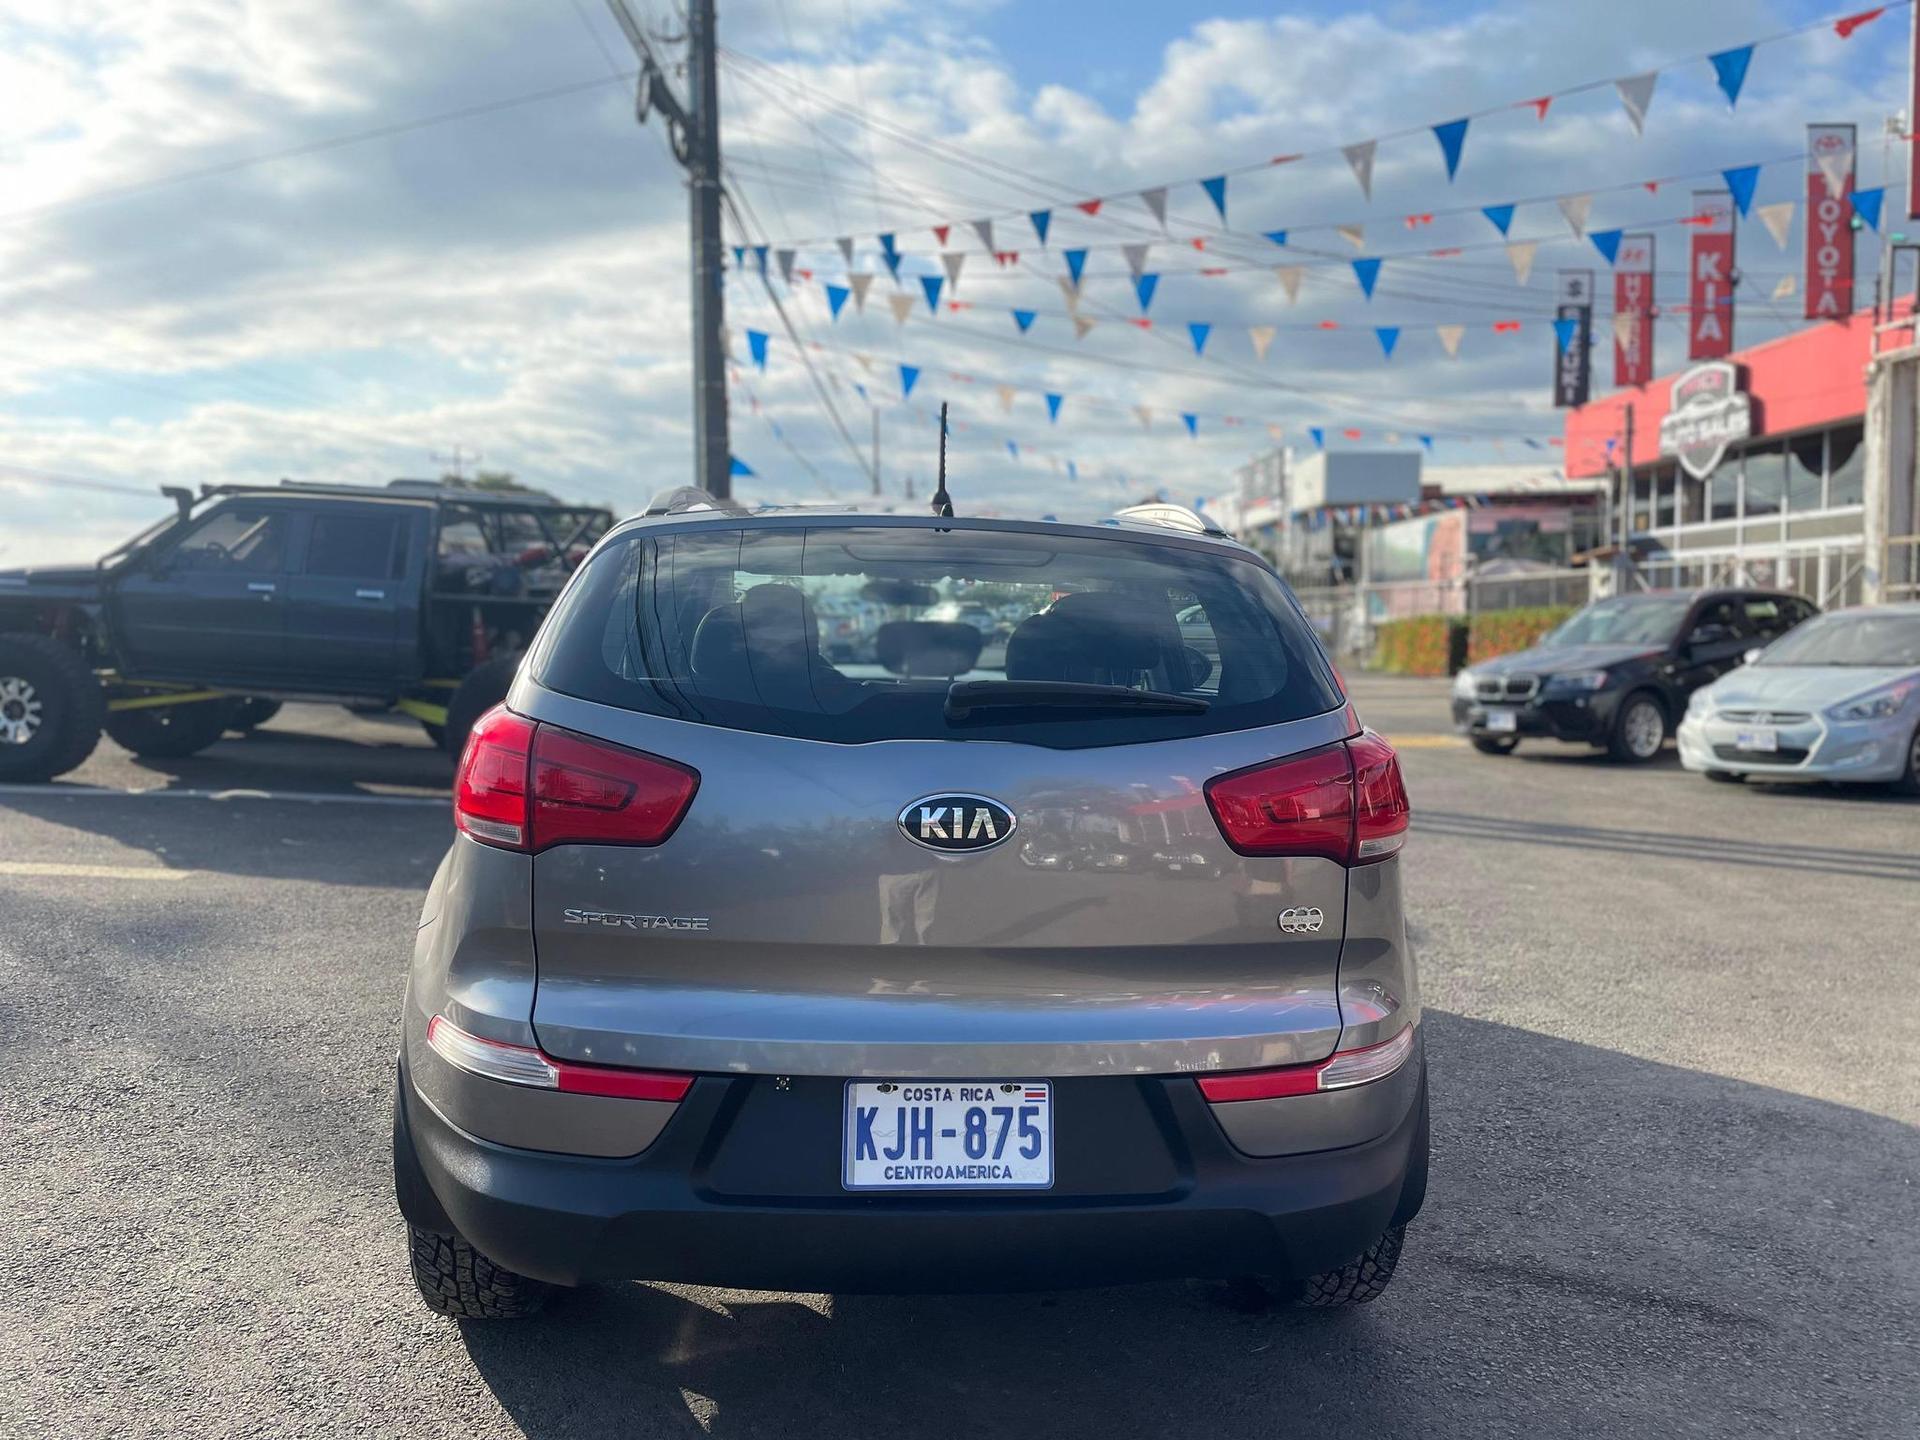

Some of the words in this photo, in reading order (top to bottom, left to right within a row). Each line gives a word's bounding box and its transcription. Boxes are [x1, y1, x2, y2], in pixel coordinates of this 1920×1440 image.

[1696, 251, 1723, 341] KIA
[919, 806, 998, 839] KIA
[563, 908, 710, 931] SPORTAGE
[903, 1087, 953, 1101] COSTA
[960, 1087, 995, 1101] RICA
[855, 1106, 1042, 1161] KJH-875
[883, 1165, 1013, 1180] CENTROAMERICA
